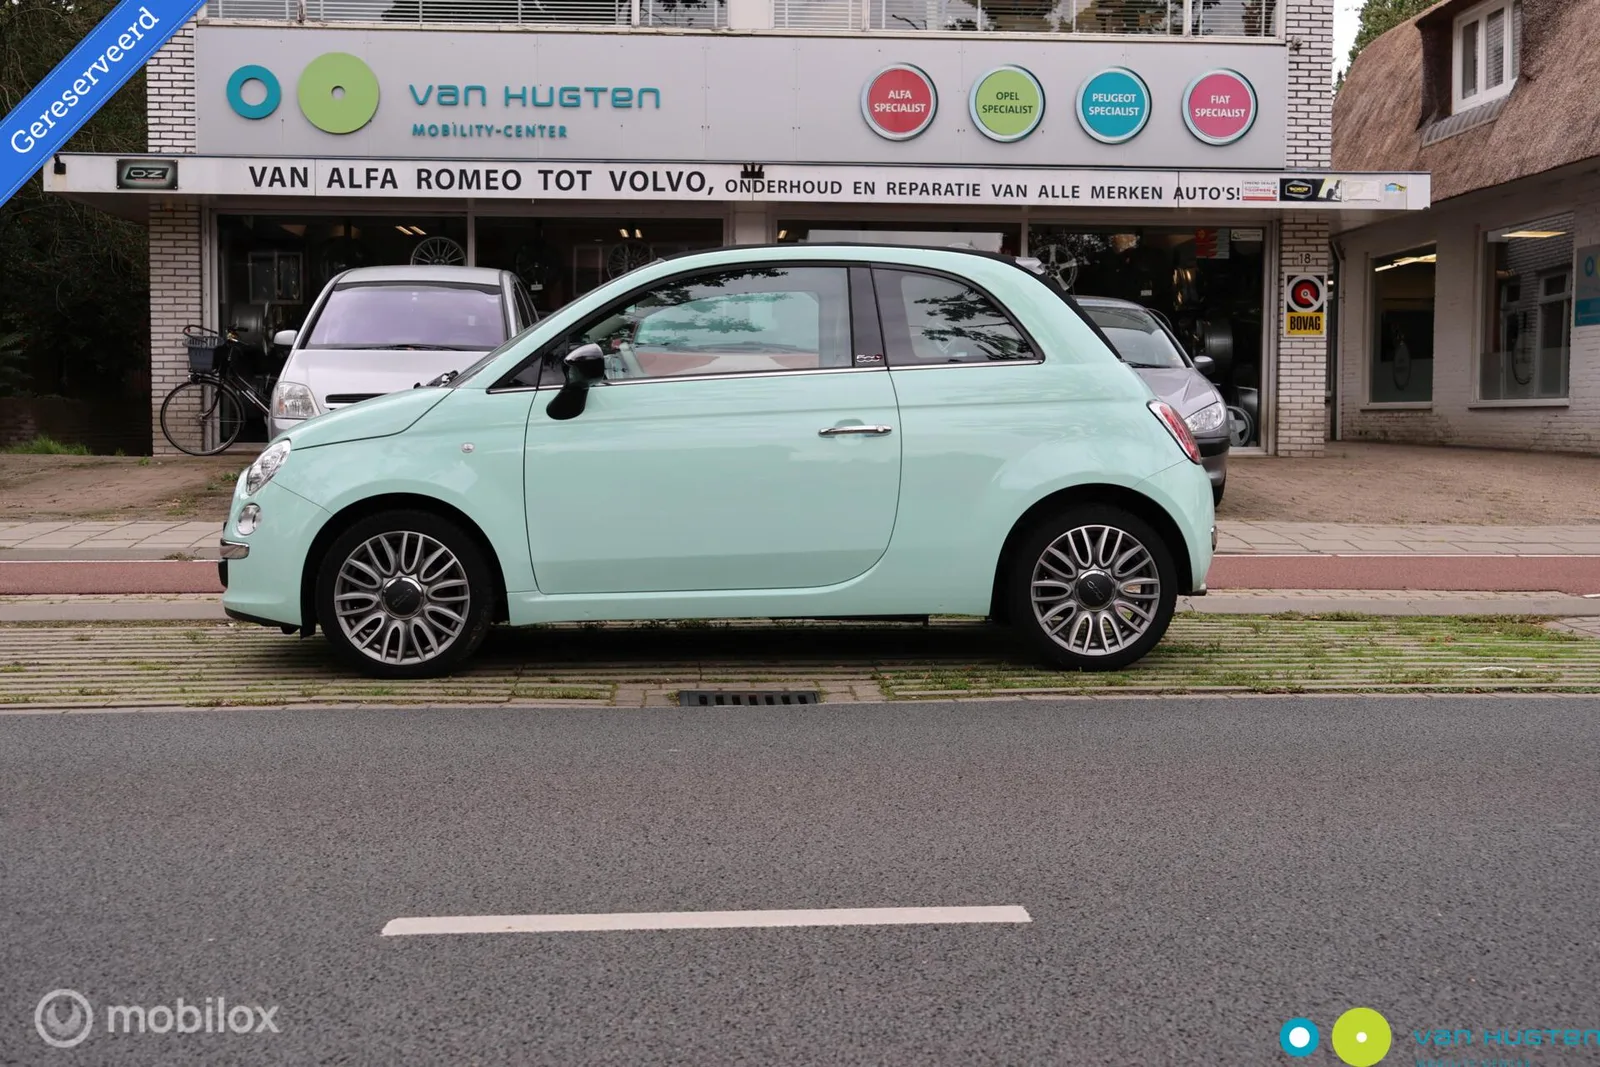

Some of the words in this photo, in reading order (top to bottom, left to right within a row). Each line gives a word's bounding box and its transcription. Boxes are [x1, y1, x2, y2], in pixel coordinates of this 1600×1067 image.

[888, 90, 912, 100] ALFA
[995, 91, 1019, 101] OPEL
[1092, 93, 1136, 103] PEUGEOT
[1211, 95, 1231, 104] FIAT
[874, 103, 926, 113] SPECIALIST
[982, 104, 1033, 114] SPECIALIST
[1089, 106, 1139, 116] SPECIALIST
[1195, 108, 1246, 118] SPECIALIST
[412, 123, 568, 139] MOBILITY-CENTER
[249, 166, 308, 188] VAN
[326, 167, 399, 189] ALFA
[416, 168, 522, 191] ROMEO
[538, 169, 592, 191] TOT
[608, 170, 714, 196] VOLVO,
[725, 178, 843, 195] ONDERHOUD
[853, 181, 876, 195] EN
[886, 182, 981, 197] REPARATIE
[991, 184, 1028, 198] VAN
[1038, 184, 1081, 199] ALLE
[1091, 185, 1163, 200] MERKEN
[1173, 186, 1241, 200] AUTO'S!
[1299, 253, 1311, 264] 18
[1290, 316, 1321, 331] BOVAG
